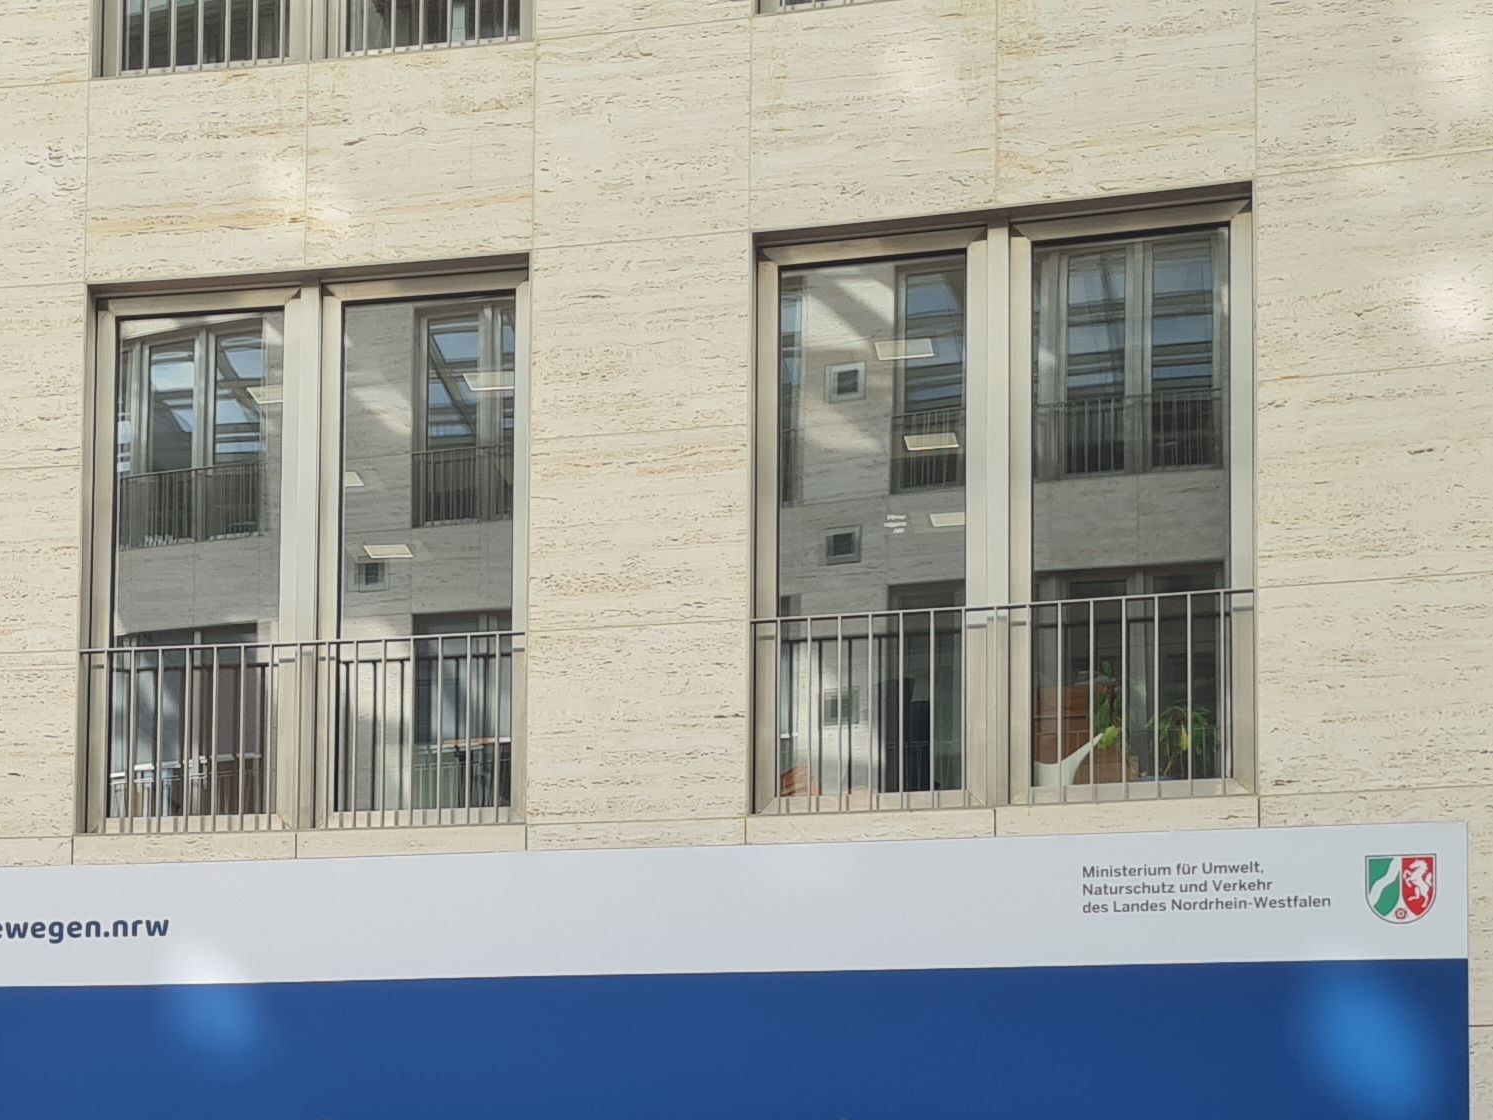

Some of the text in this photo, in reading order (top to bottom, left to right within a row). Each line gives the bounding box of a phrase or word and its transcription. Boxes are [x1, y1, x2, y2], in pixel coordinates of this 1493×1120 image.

[1082, 860, 1265, 879] Ministerium für Umwelt,
[1082, 878, 1273, 896] Naturschutz und Verkehr
[1082, 895, 1332, 914] des Landes Nordrhein-Westfalen
